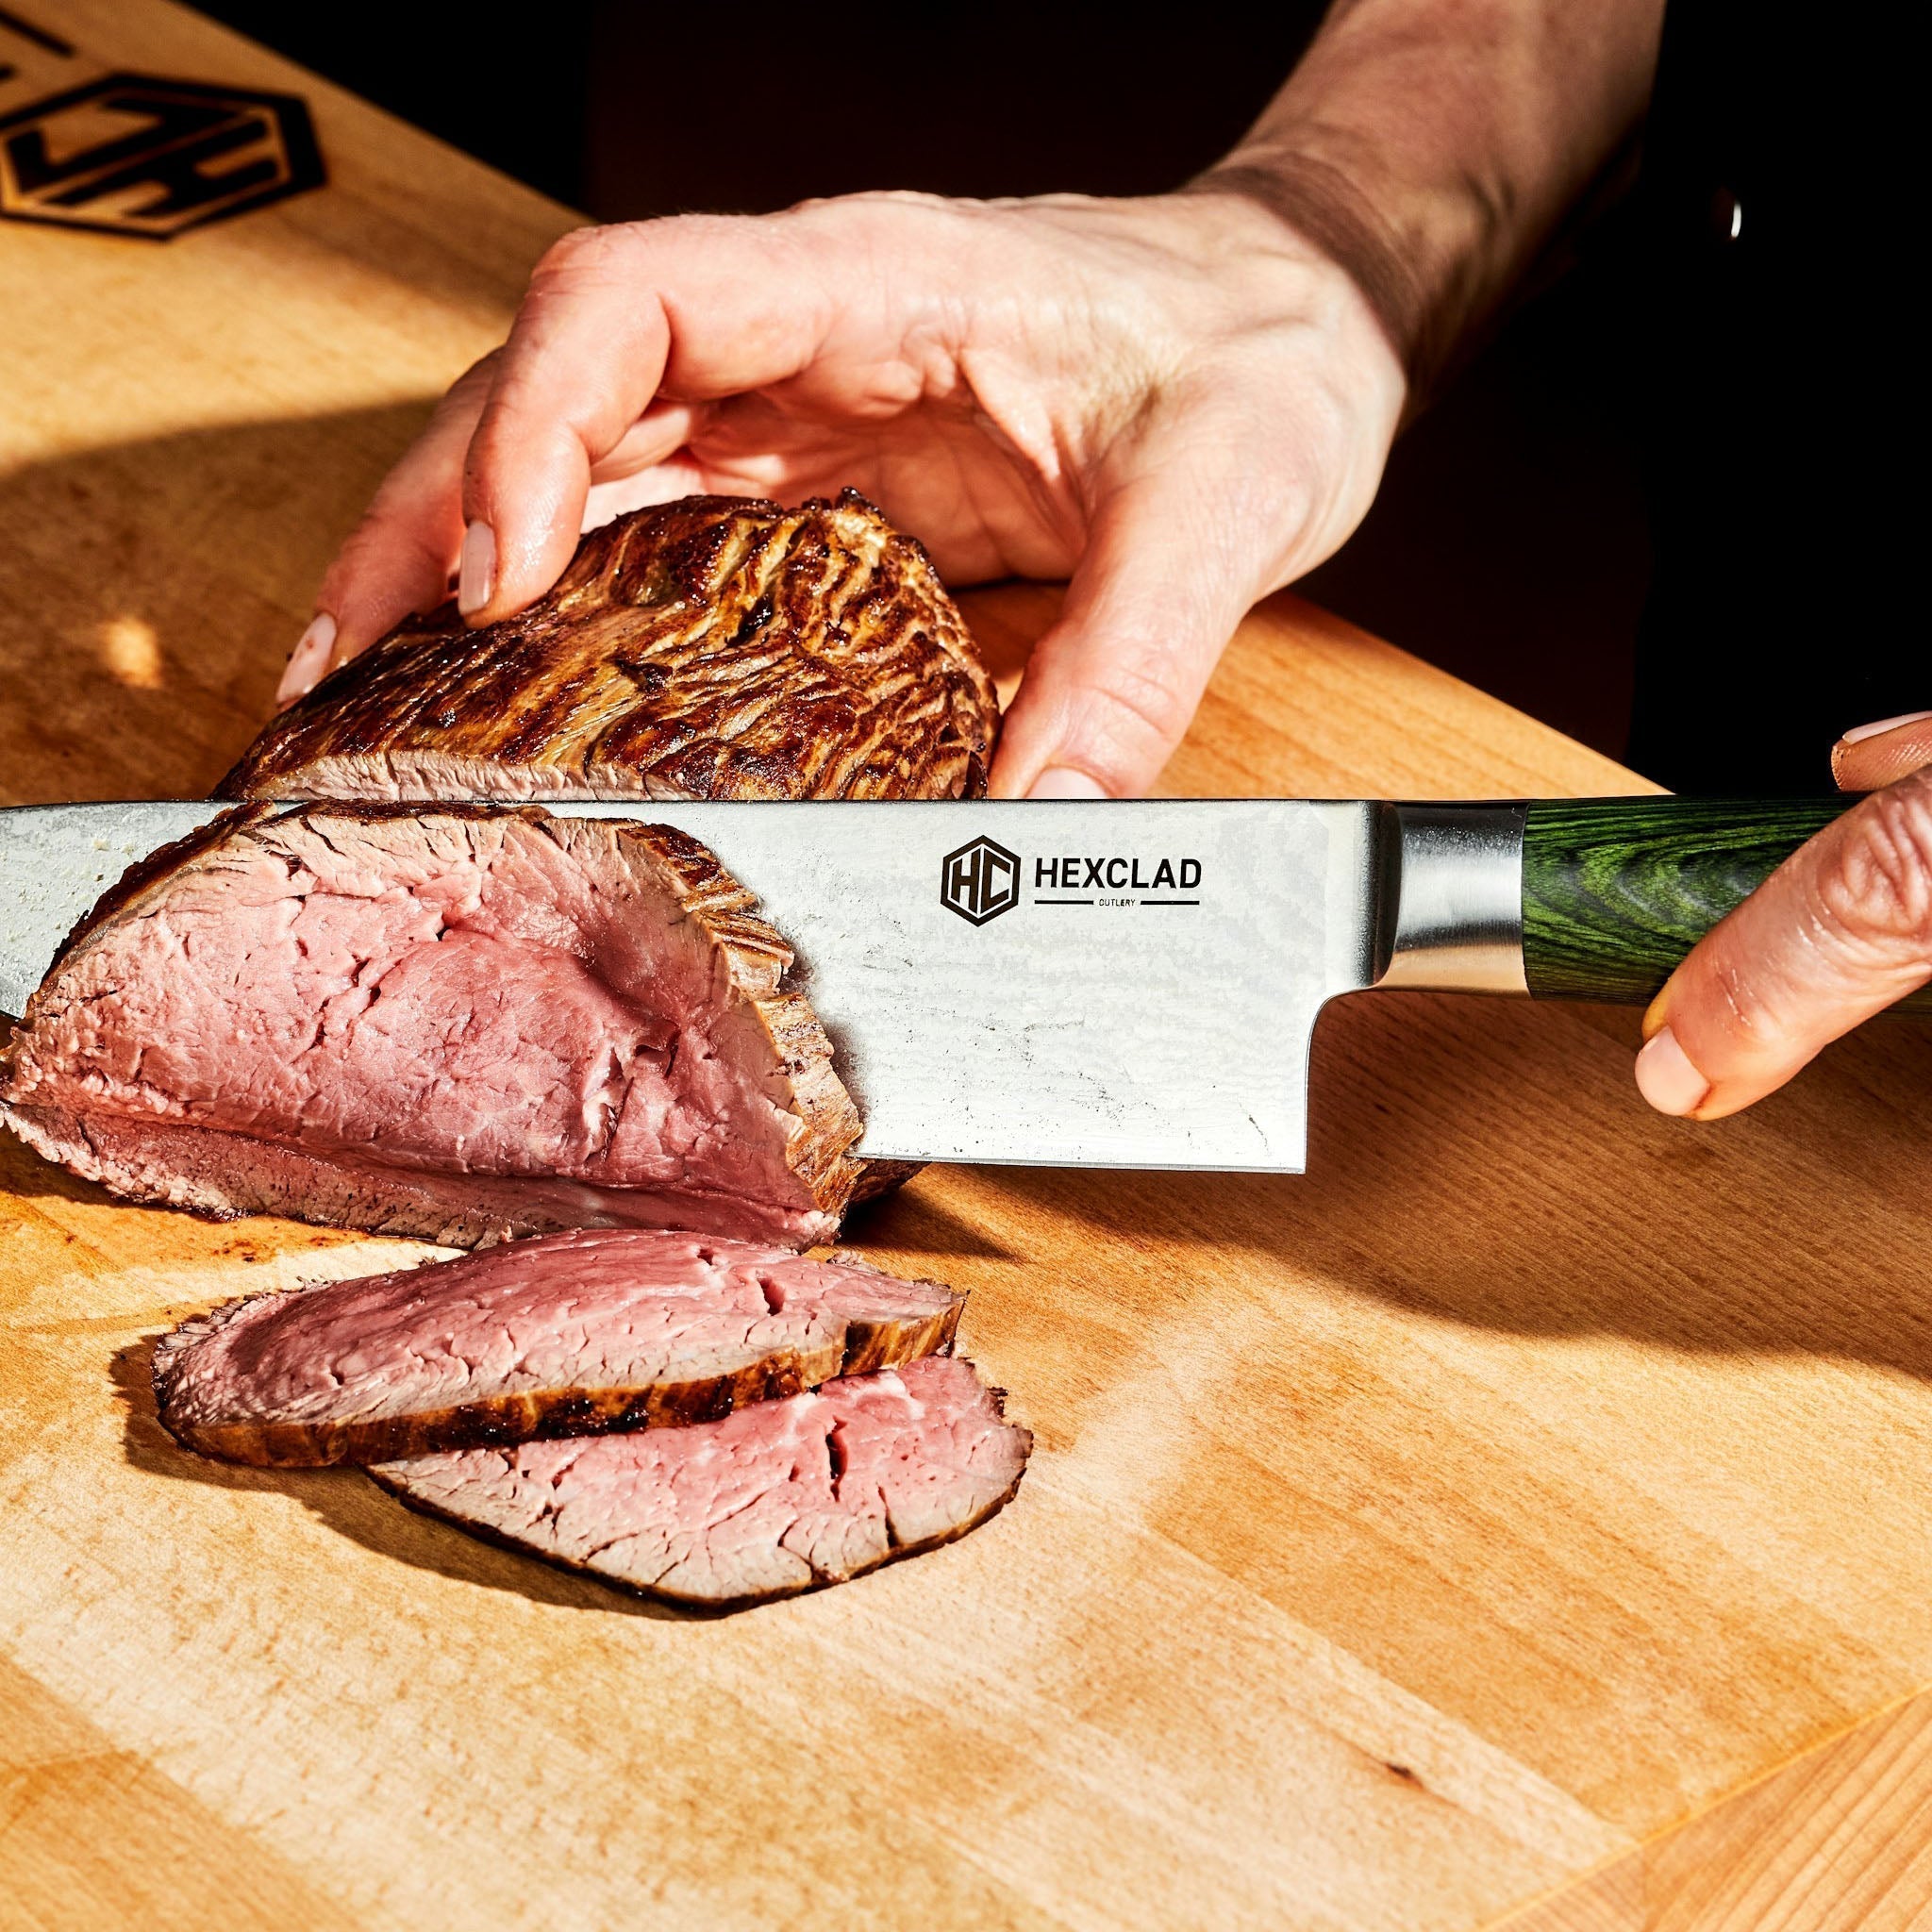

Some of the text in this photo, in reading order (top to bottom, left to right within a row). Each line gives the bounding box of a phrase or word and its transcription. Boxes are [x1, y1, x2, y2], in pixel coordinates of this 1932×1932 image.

[950, 844, 1012, 916] HC
[1035, 858, 1202, 889] HEXCLAD
[1099, 898, 1136, 907] CUTLERY
